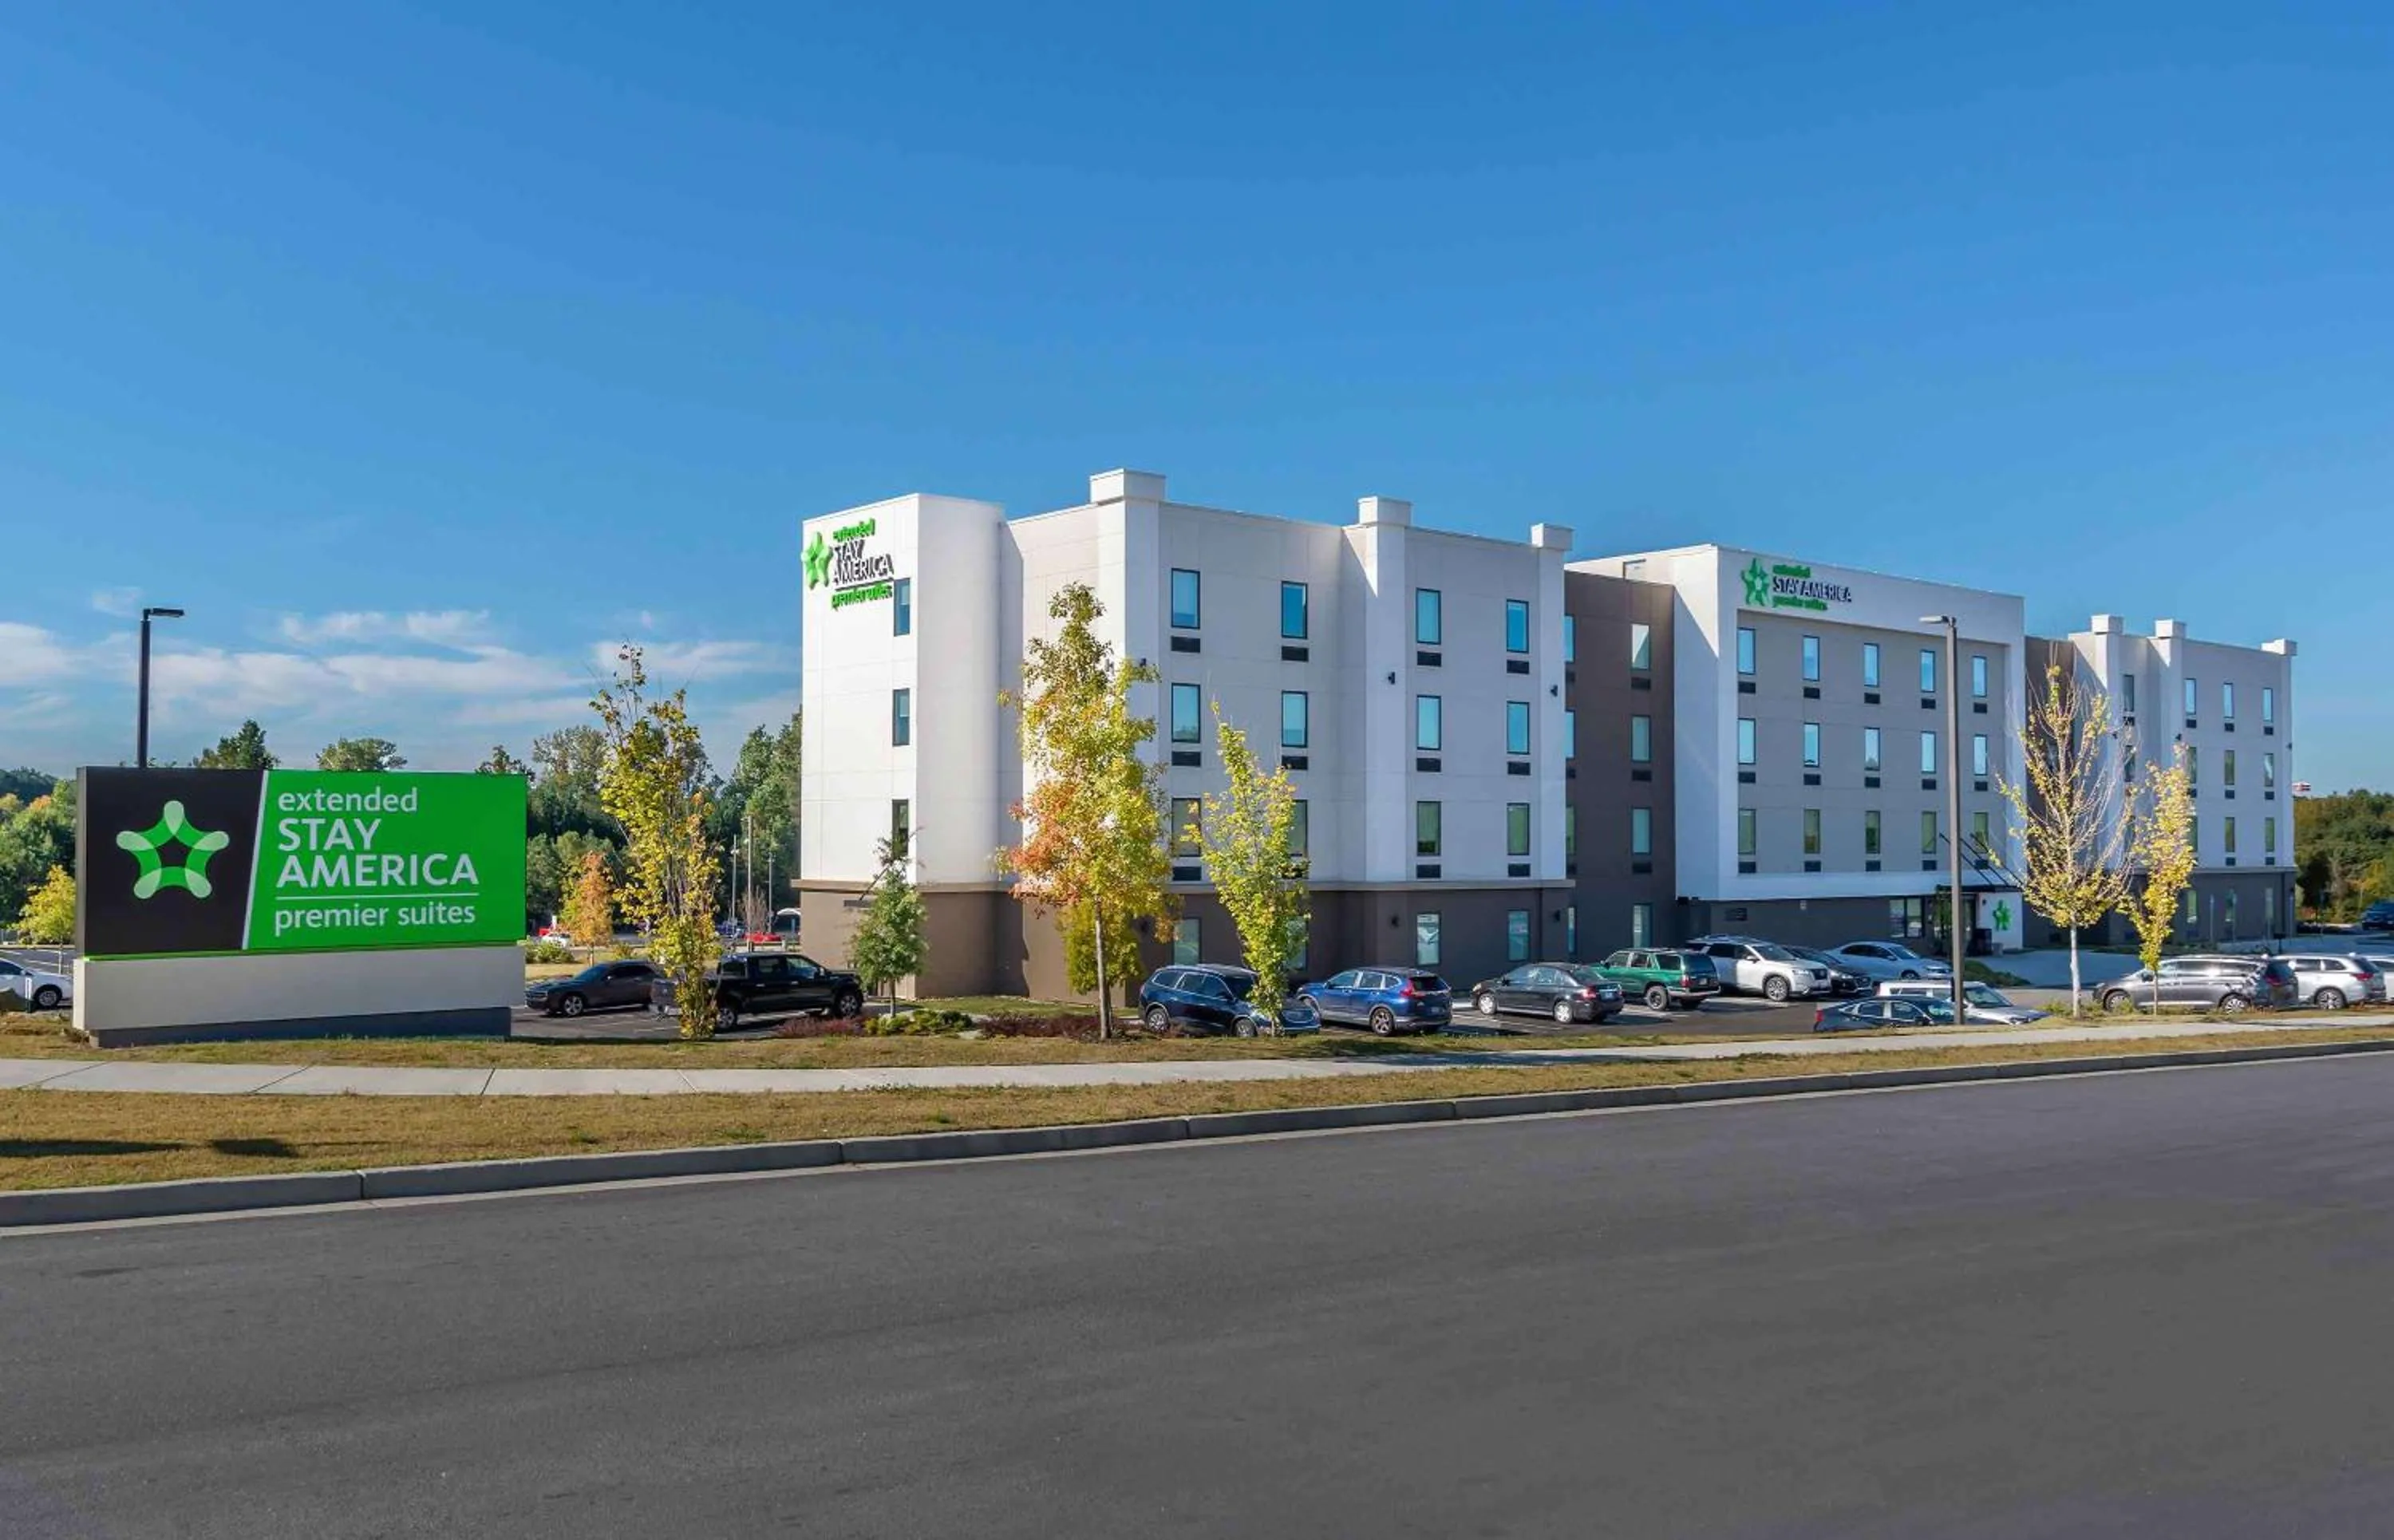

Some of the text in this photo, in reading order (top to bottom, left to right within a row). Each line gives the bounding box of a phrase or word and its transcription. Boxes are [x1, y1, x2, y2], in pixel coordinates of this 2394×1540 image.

[833, 554, 894, 585] AMERICA
[1799, 580, 1852, 602] AMERICA
[278, 786, 417, 812] extended
[279, 817, 381, 852] STAY
[276, 854, 479, 888] AMERICA
[275, 902, 475, 937] premier suites
